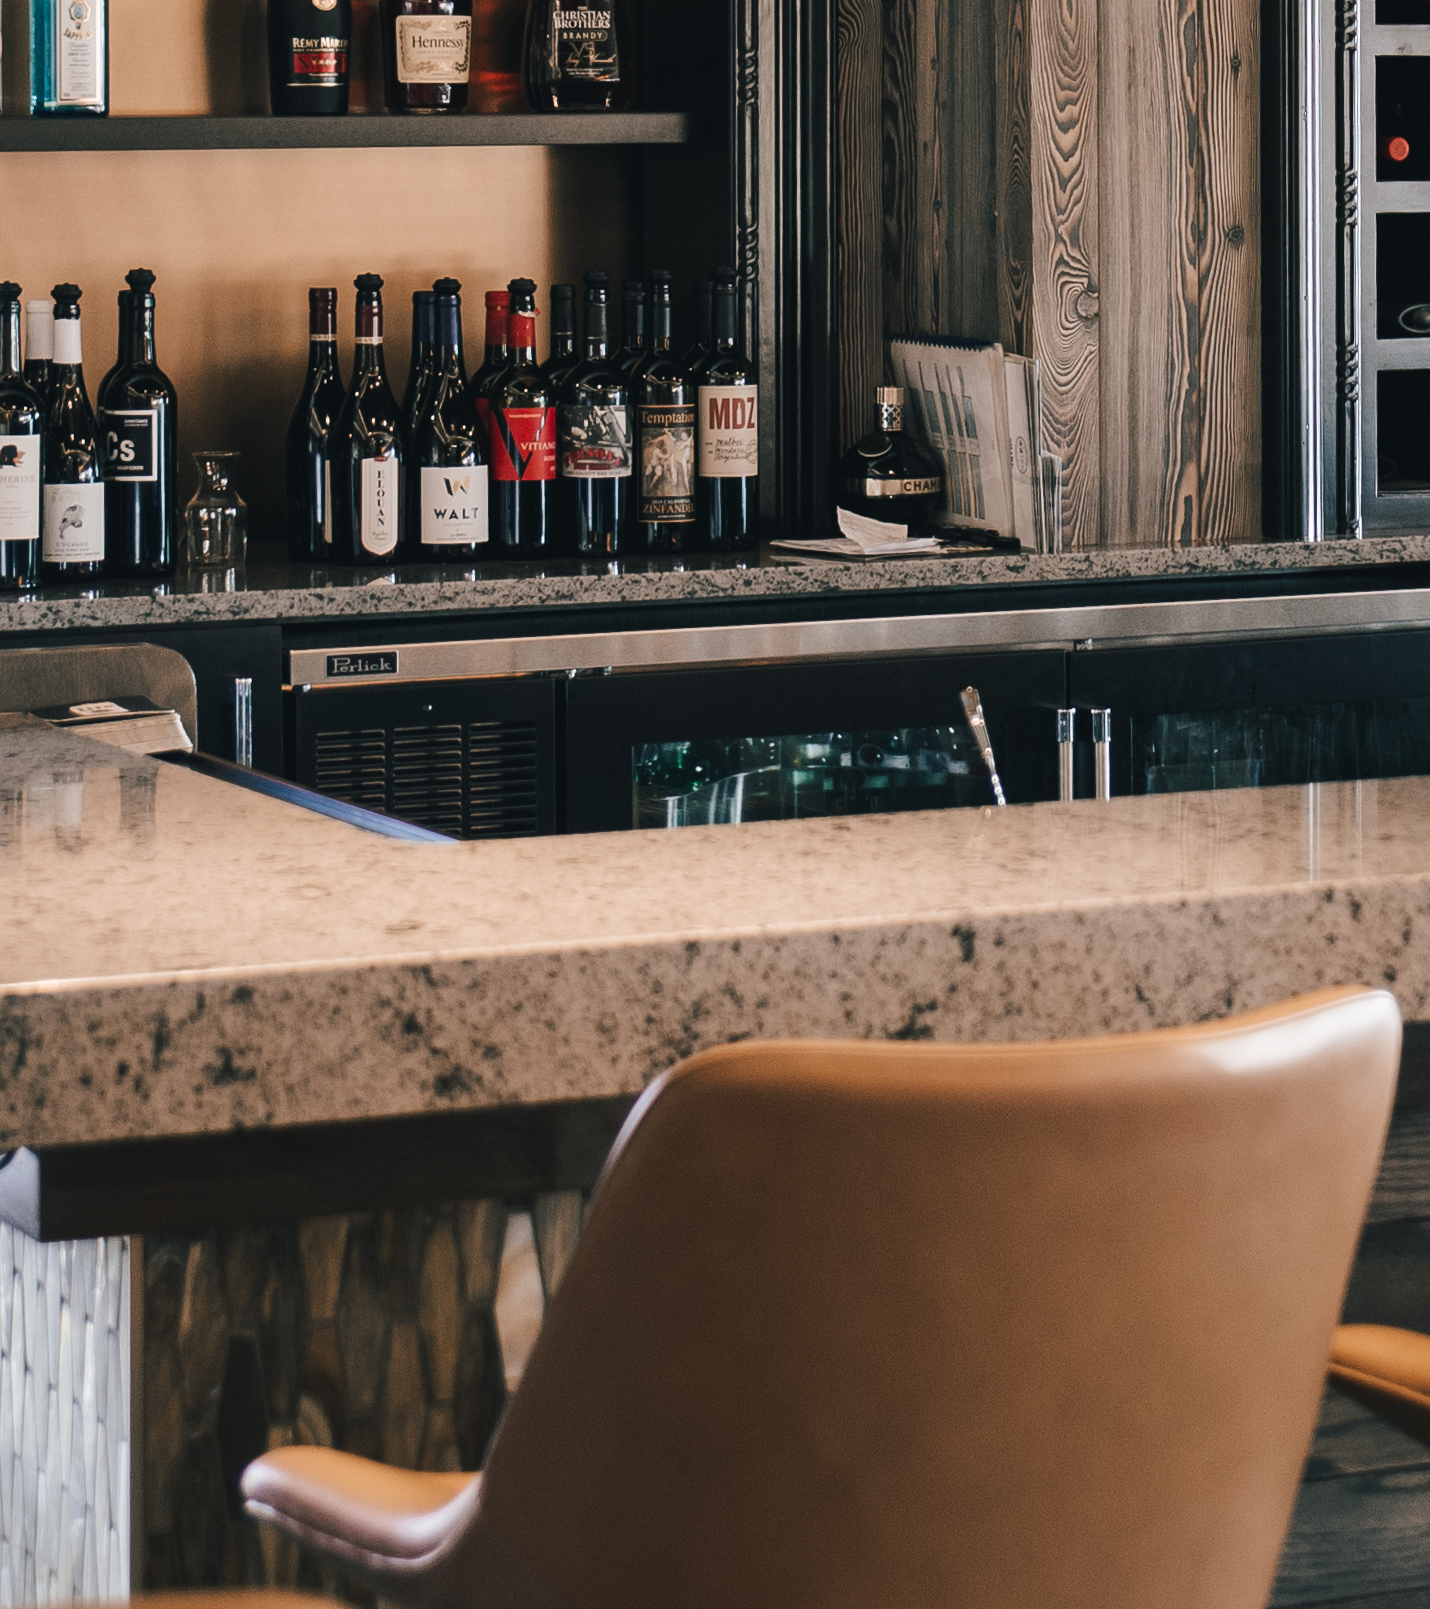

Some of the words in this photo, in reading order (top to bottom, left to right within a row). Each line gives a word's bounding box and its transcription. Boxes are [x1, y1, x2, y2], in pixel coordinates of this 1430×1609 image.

[553, 10, 611, 20] CHRISTIAN
[554, 20, 611, 29] BROTHERS
[412, 35, 464, 51] Hennessy
[563, 32, 603, 40] BRANDY
[709, 397, 755, 430] MDZ
[107, 431, 136, 462] Cs
[377, 470, 386, 527] ELOUAN
[433, 507, 479, 520] WALT
[332, 657, 393, 674] Perlick
